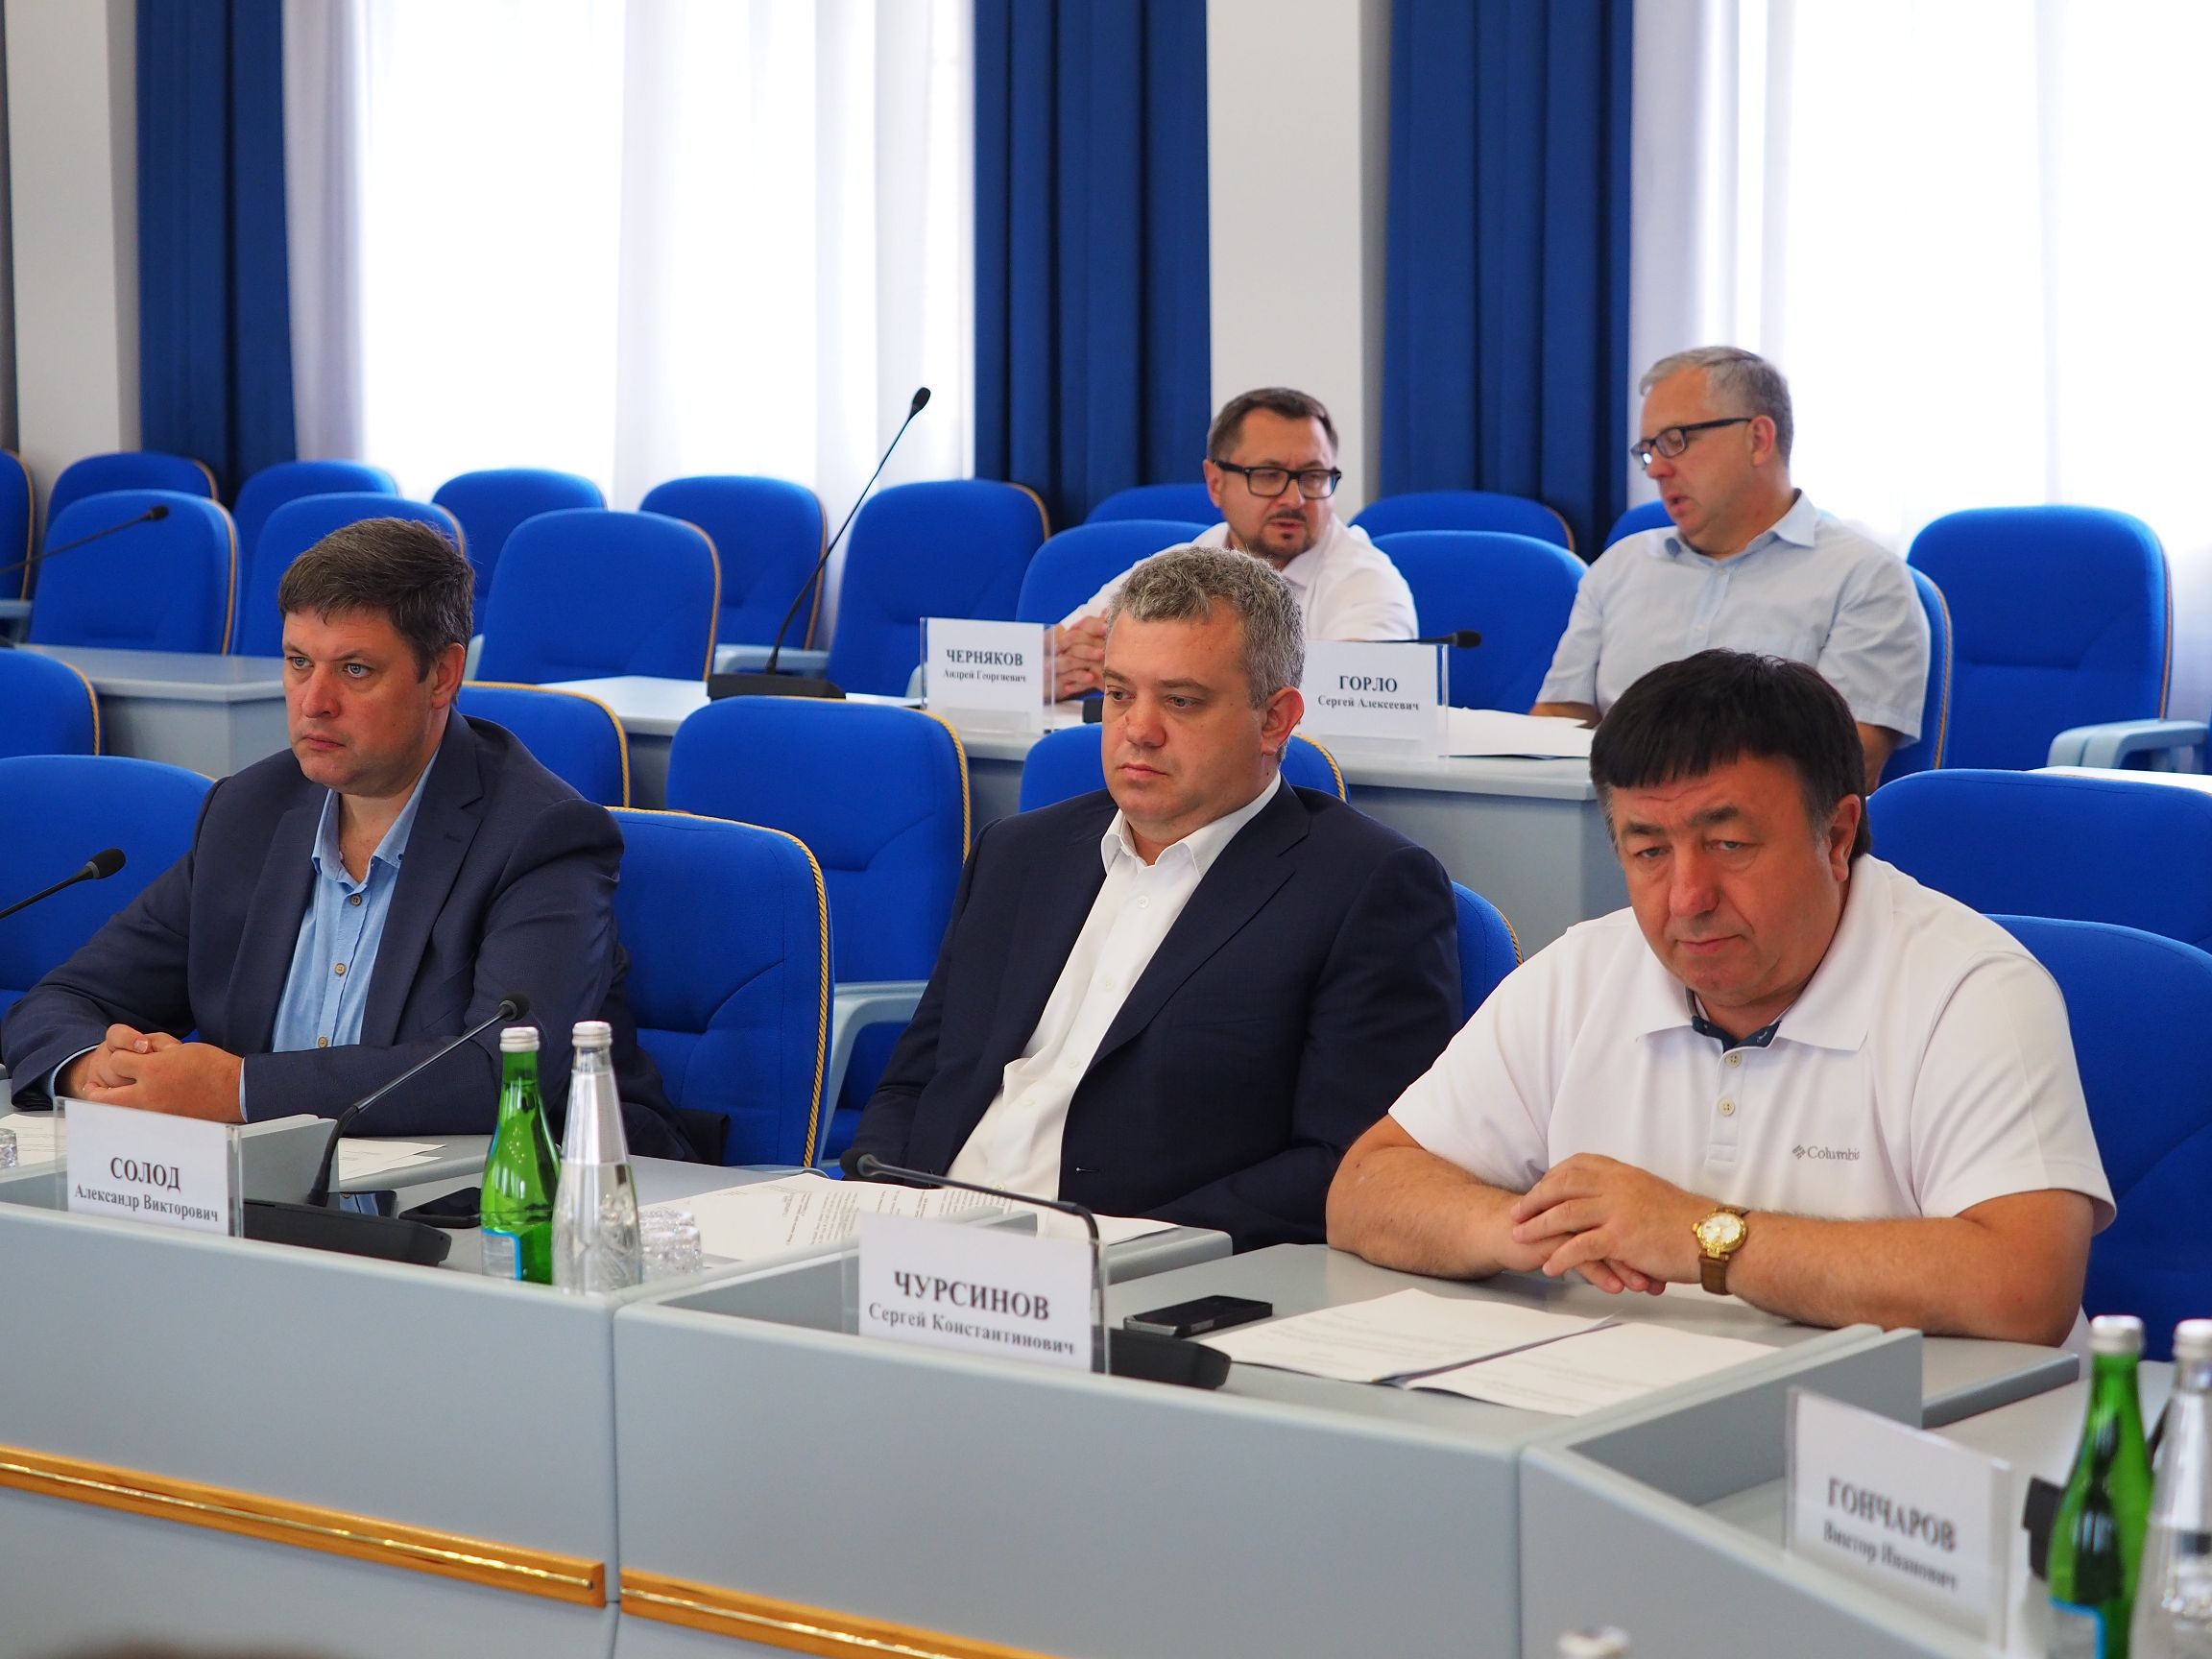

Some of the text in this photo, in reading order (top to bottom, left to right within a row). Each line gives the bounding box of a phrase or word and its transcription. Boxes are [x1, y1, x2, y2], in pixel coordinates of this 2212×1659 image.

[946, 649, 1023, 666] ЧЕРНЯКОВ
[1317, 694, 1419, 710] Сергей Алексеевич
[1339, 675, 1398, 692] ГОРЛО
[110, 1157, 180, 1193] СОЛОД
[74, 1183, 218, 1222] Александр Викторович
[894, 1270, 1049, 1321] ЧУРСИНОВ
[868, 1302, 1075, 1356] Сергей Константинович
[1828, 1477, 1957, 1553] ГОНЧАРОВ
